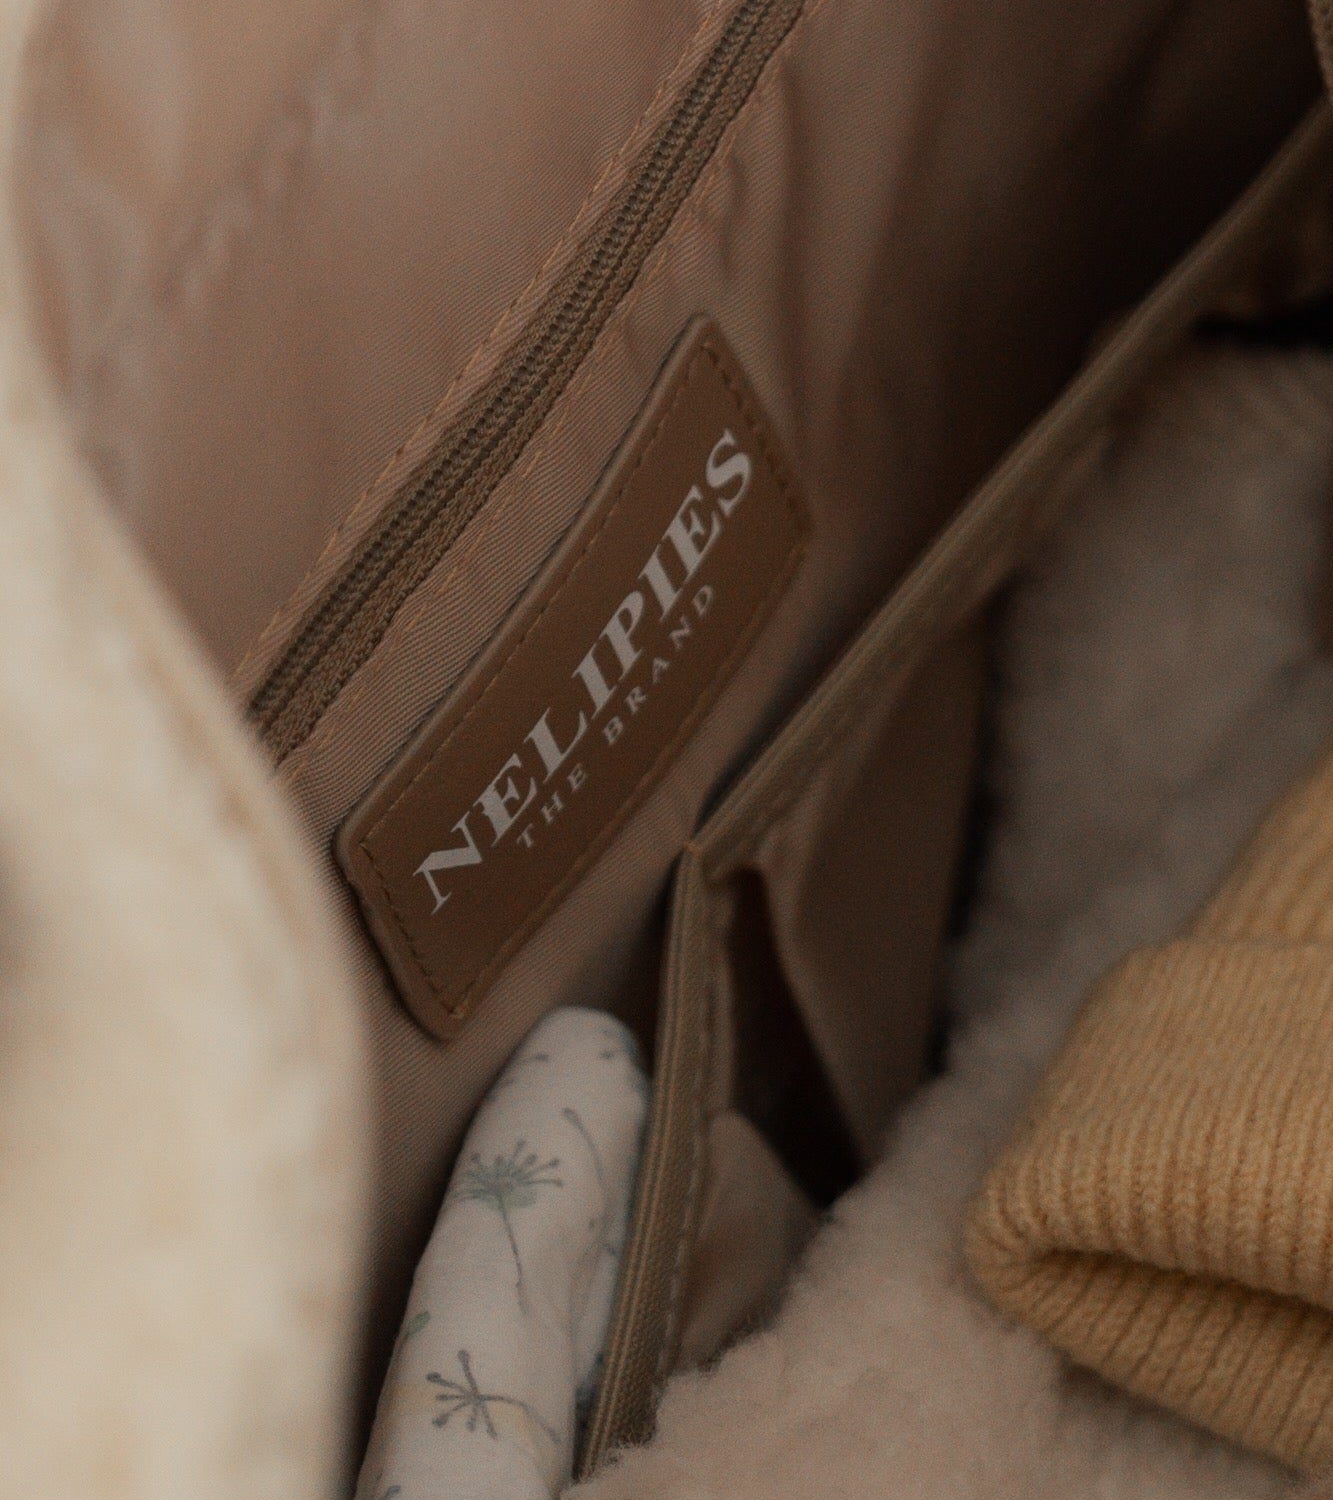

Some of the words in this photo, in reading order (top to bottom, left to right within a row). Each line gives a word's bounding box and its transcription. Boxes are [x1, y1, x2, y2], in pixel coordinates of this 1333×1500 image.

[412, 430, 752, 914] NELIPIES
[517, 765, 588, 849] THE
[602, 584, 715, 746] BRAND
